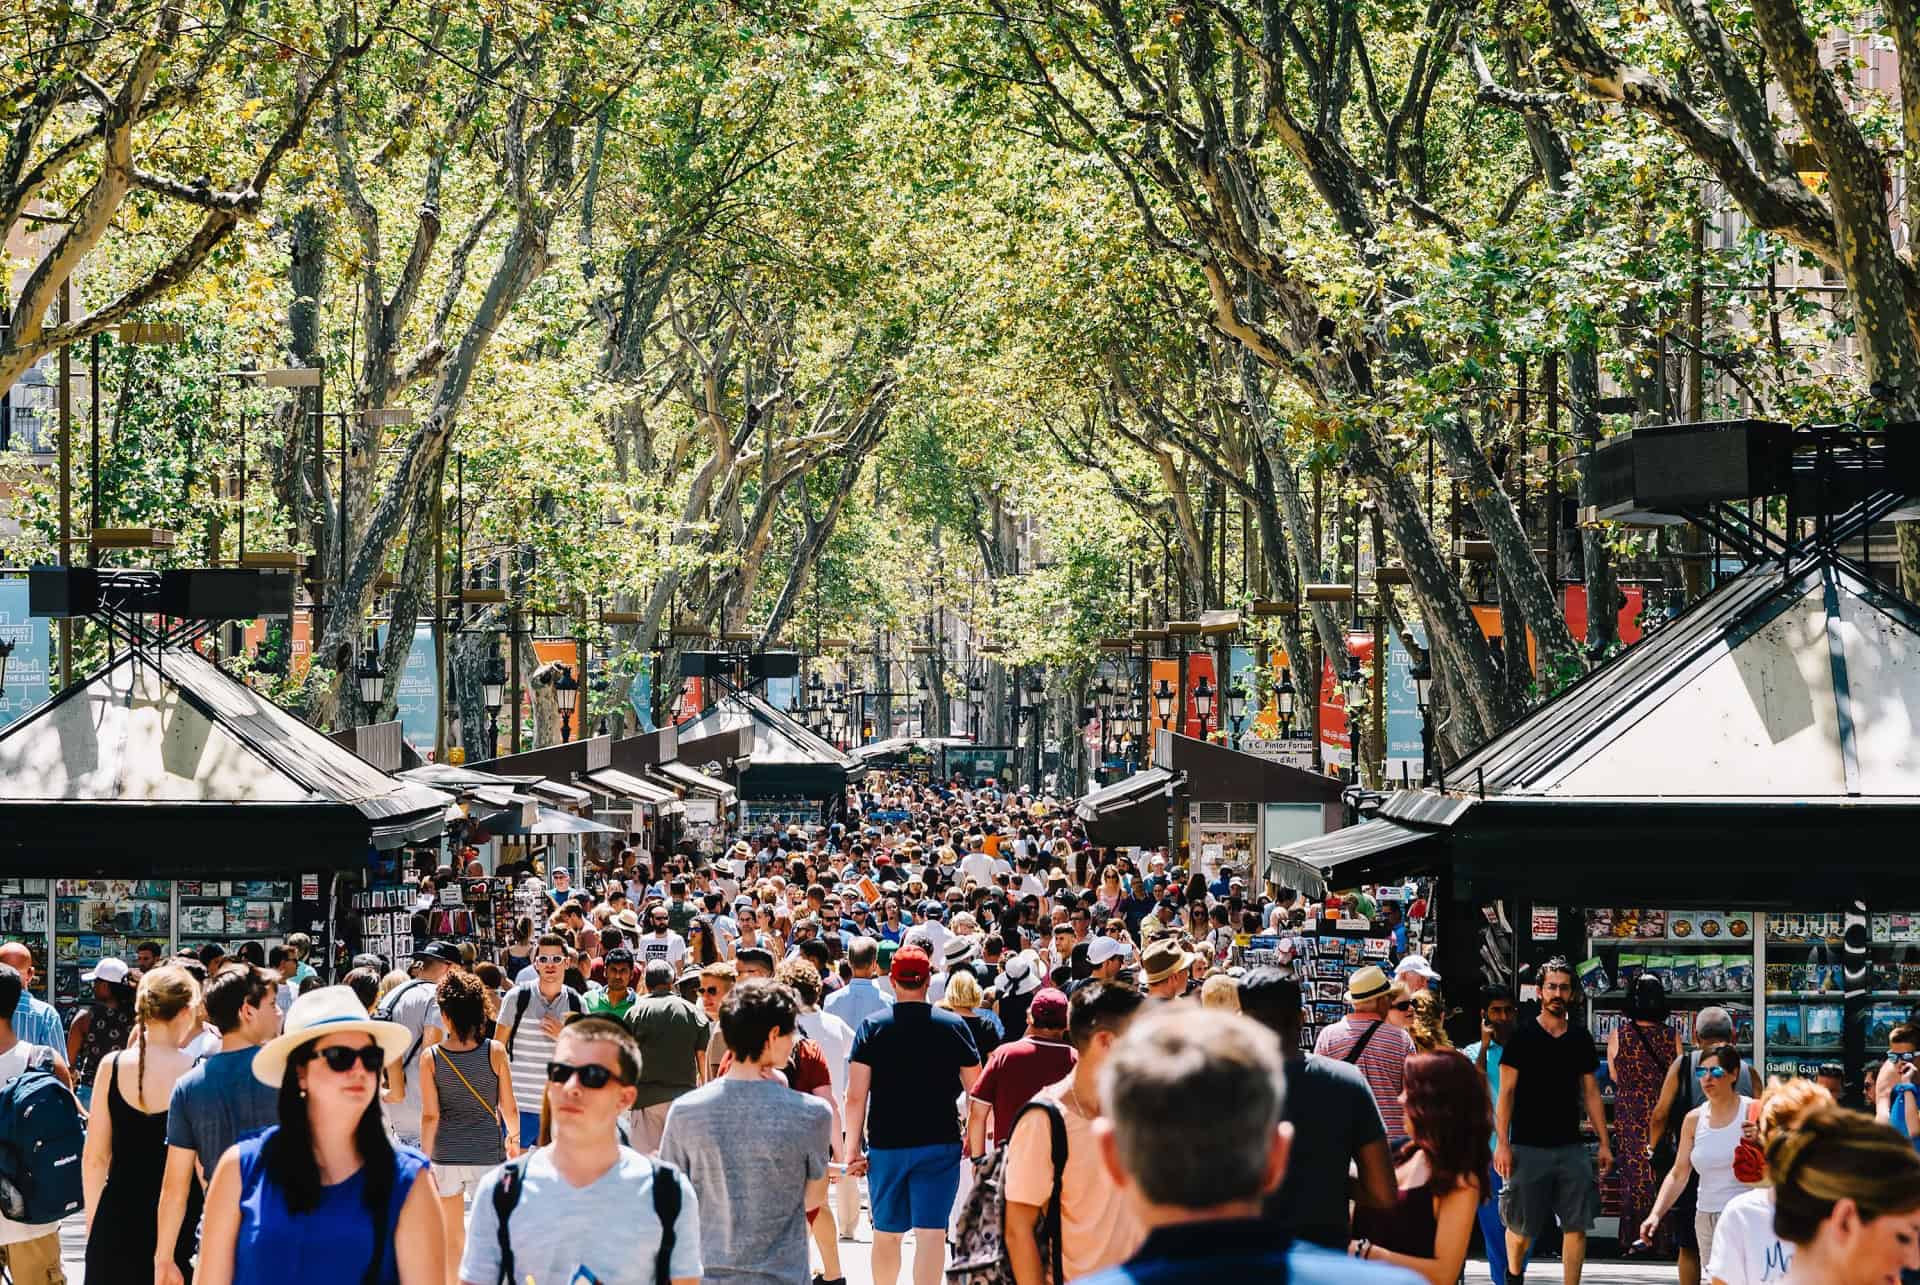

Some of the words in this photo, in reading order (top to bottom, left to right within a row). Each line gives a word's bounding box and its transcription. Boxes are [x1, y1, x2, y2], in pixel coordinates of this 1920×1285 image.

[1265, 741, 1287, 749] Pintor
[1289, 741, 1312, 749] Fortun
[1799, 1063, 1819, 1073] Gau
